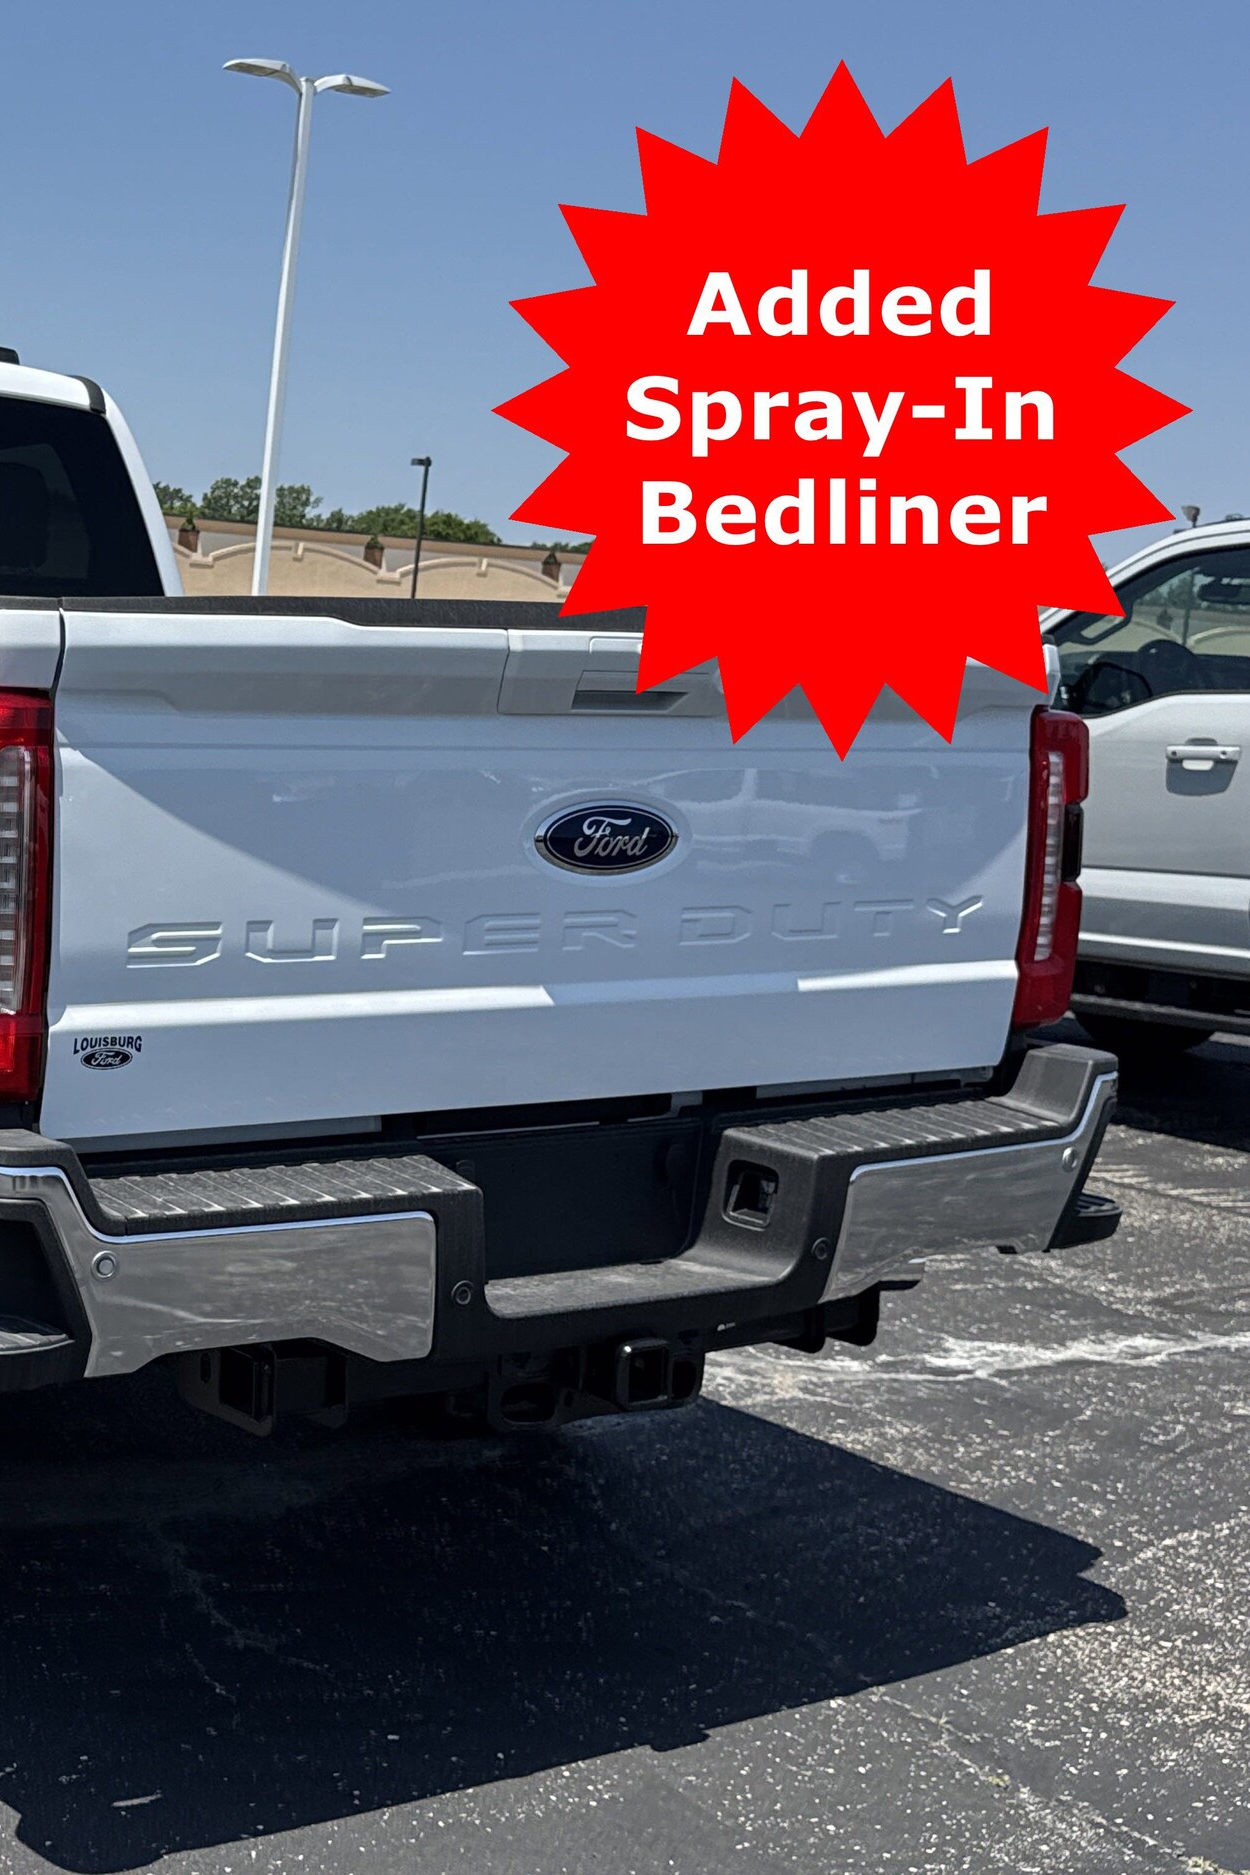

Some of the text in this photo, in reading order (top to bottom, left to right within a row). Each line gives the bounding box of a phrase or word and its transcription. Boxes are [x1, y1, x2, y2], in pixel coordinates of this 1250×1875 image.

[574, 816, 650, 857] Ford
[126, 895, 983, 969] SUPER DUTY
[73, 1035, 142, 1055] LOUISBURG
